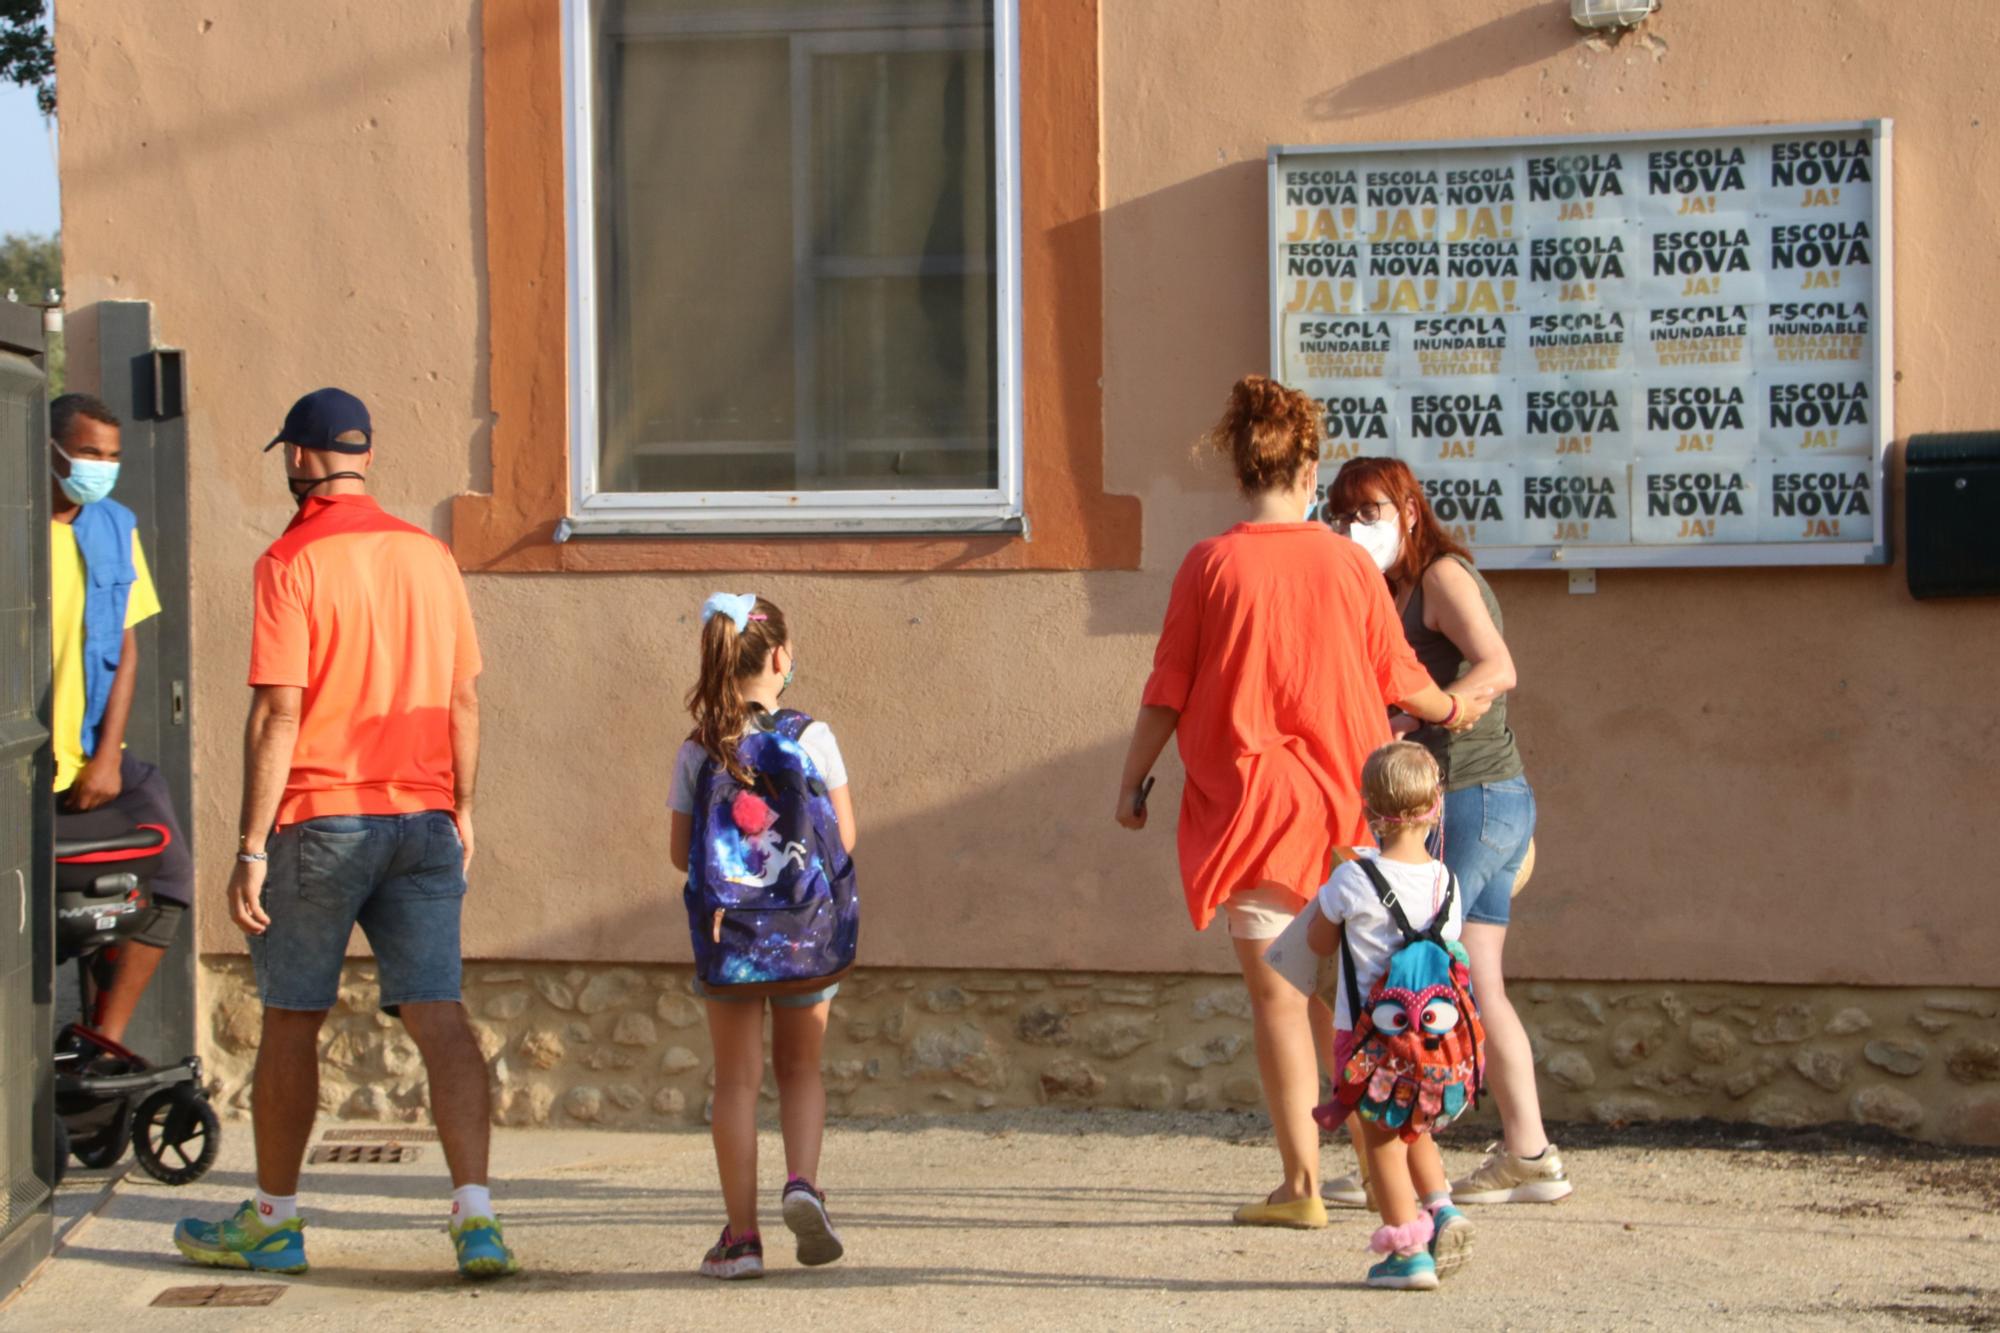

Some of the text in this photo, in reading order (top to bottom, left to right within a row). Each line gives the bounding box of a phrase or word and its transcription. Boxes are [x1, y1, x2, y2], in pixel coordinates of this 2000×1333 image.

[1649, 147, 1745, 170] ESCOLA
[1771, 139, 1871, 161] ESCOLA
[1528, 153, 1622, 176] ESCOLA
[1771, 158, 1871, 187] NOVA
[1286, 170, 1357, 186] ESCOLA
[1366, 171, 1438, 186] ESCOLA
[1446, 167, 1515, 185] ESCOLA
[1649, 166, 1745, 195] NOVA
[1286, 186, 1358, 206] NOVA
[1367, 186, 1438, 206] NOVA
[1446, 183, 1515, 206] NOVA
[1528, 171, 1624, 202] NOVA
[1677, 195, 1716, 215] JA!
[1801, 188, 1840, 208] JA!
[1557, 202, 1594, 221] JA!
[1287, 207, 1356, 241] JA!
[1367, 207, 1437, 242] JA!
[1446, 204, 1513, 241] JA!
[1771, 221, 1870, 244] ESCOLA
[1370, 242, 1440, 257] ESCOLA
[1447, 242, 1519, 257] ESCOLA
[1530, 235, 1624, 257] ESCOLA
[1652, 228, 1750, 251] ESCOLA
[1288, 243, 1358, 257] ESCOLA
[1771, 240, 1871, 270] NOVA
[1288, 257, 1356, 278] NOVA
[1370, 257, 1440, 277] NOVA
[1447, 258, 1519, 277] NOVA
[1530, 253, 1625, 282] NOVA
[1653, 248, 1751, 276] NOVA
[1682, 276, 1721, 296] JA!
[1801, 270, 1840, 289] JA!
[1286, 279, 1355, 314] JA!
[1369, 279, 1438, 313] JA!
[1446, 279, 1517, 313] JA!
[1558, 283, 1597, 302] JA!
[1650, 304, 1747, 325] ESCOLA
[1769, 302, 1868, 321] ESCOLA
[1300, 321, 1391, 339] ESCOLA
[1414, 318, 1507, 336] ESCOLA
[1529, 312, 1624, 332] ESCOLA
[1769, 322, 1868, 335] INUNDABLE
[1529, 331, 1624, 347] INUNDABLE
[1650, 324, 1747, 341] INUNDABLE
[1300, 339, 1390, 353] INUNDABLE
[1414, 336, 1506, 351] INUNDABLE
[1527, 390, 1618, 409] ESCOLA
[1648, 387, 1744, 406] ESCOLA
[1769, 382, 1868, 402] ESCOLA
[1312, 397, 1388, 414] COLA
[1411, 394, 1503, 413] ESCOLA
[1527, 408, 1620, 434] NOVA
[1648, 405, 1744, 431] NOVA
[1769, 400, 1868, 428] NOVA
[1325, 415, 1388, 438] OVA
[1411, 413, 1503, 438] NOVA
[1556, 435, 1593, 454] JA!
[1675, 434, 1714, 452] JA!
[1799, 430, 1838, 449] JA!
[1439, 441, 1474, 459] JA!
[1524, 477, 1616, 495] ESCOLA
[1647, 473, 1743, 492] ESCOLA
[1772, 472, 1871, 492] ESCOLA
[1431, 497, 1503, 521] OVA
[1524, 495, 1617, 520] NOVA
[1647, 491, 1743, 517] NOVA
[1772, 491, 1871, 517] NOVA
[1452, 524, 1476, 542] A!
[1553, 522, 1590, 540] JA!
[1677, 519, 1715, 538] JA!
[1802, 519, 1840, 538] JA!
